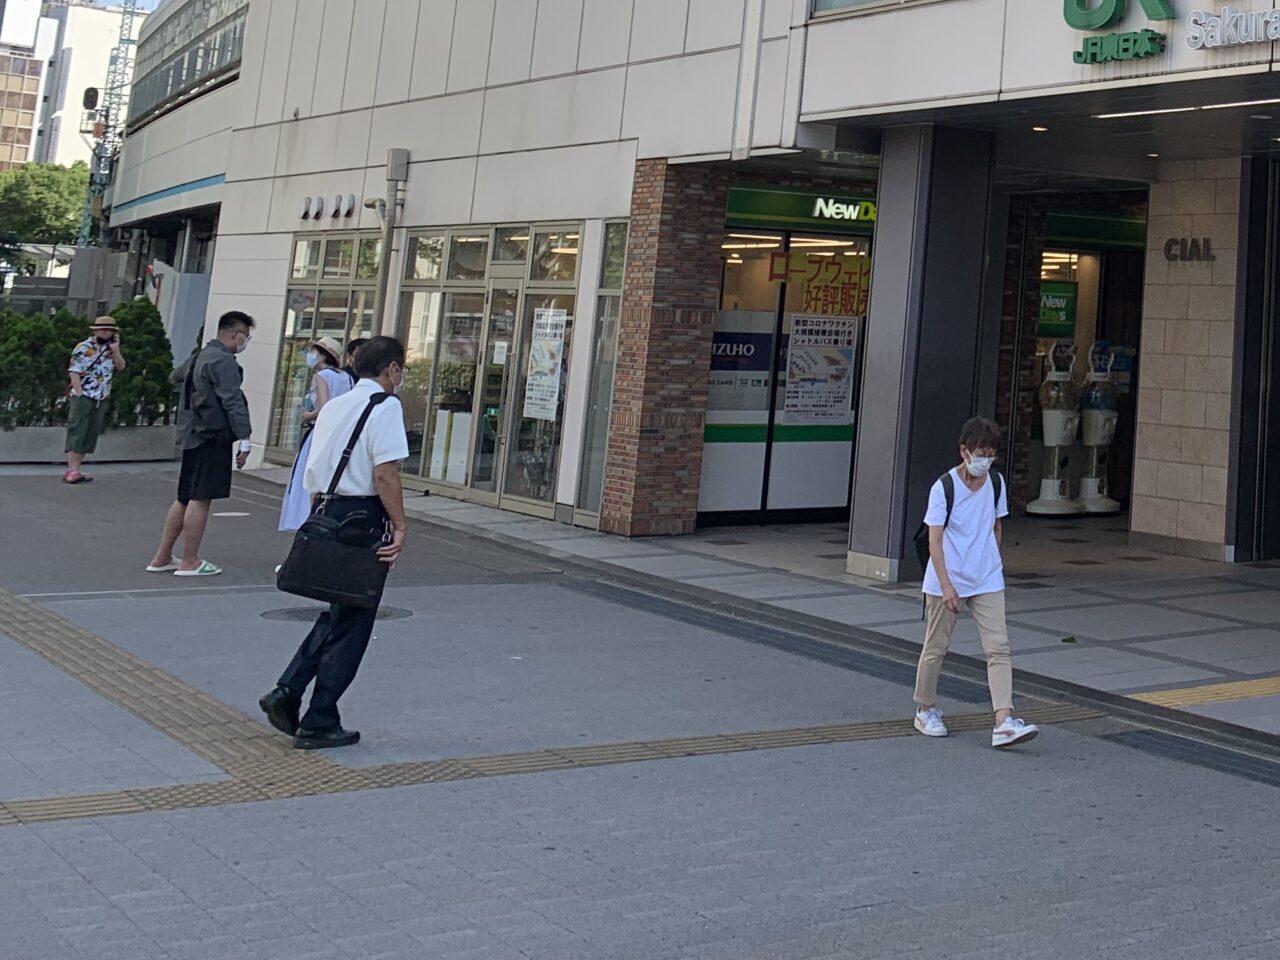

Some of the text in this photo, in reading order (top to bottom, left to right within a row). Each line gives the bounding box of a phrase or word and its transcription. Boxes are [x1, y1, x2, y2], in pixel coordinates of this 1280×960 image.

[1073, 28, 1164, 65] JR東日本
[812, 198, 877, 222] NewD
[1164, 238, 1215, 262] CIAL
[1040, 295, 1067, 309] New
